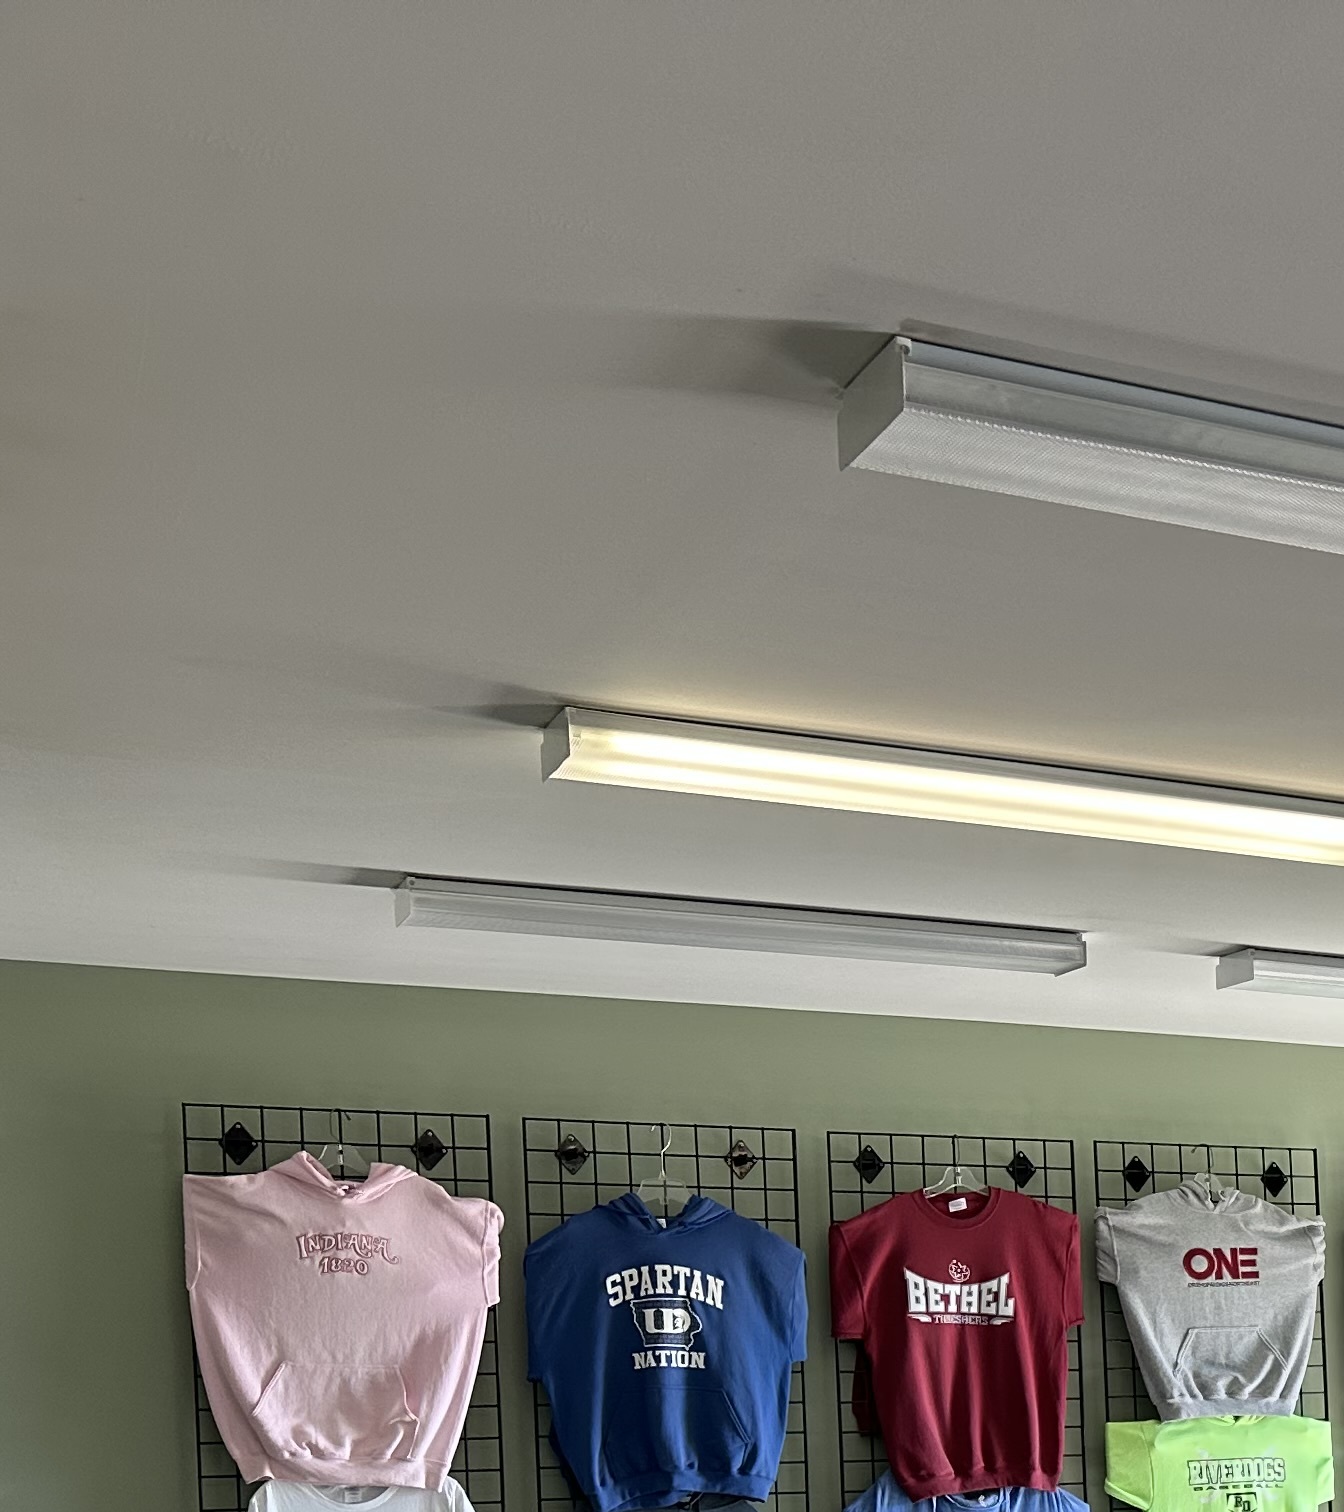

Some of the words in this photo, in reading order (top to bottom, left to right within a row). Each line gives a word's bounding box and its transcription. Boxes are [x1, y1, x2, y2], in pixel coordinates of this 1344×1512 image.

[296, 1232, 399, 1264] INDIANA
[1183, 1248, 1260, 1280] ONE
[319, 1256, 369, 1275] 1820
[605, 1264, 724, 1310] SPARTAN
[903, 1267, 1015, 1317] BETHEL
[632, 1350, 706, 1369] NATION
[1187, 1457, 1286, 1485] RIVERDOGS
